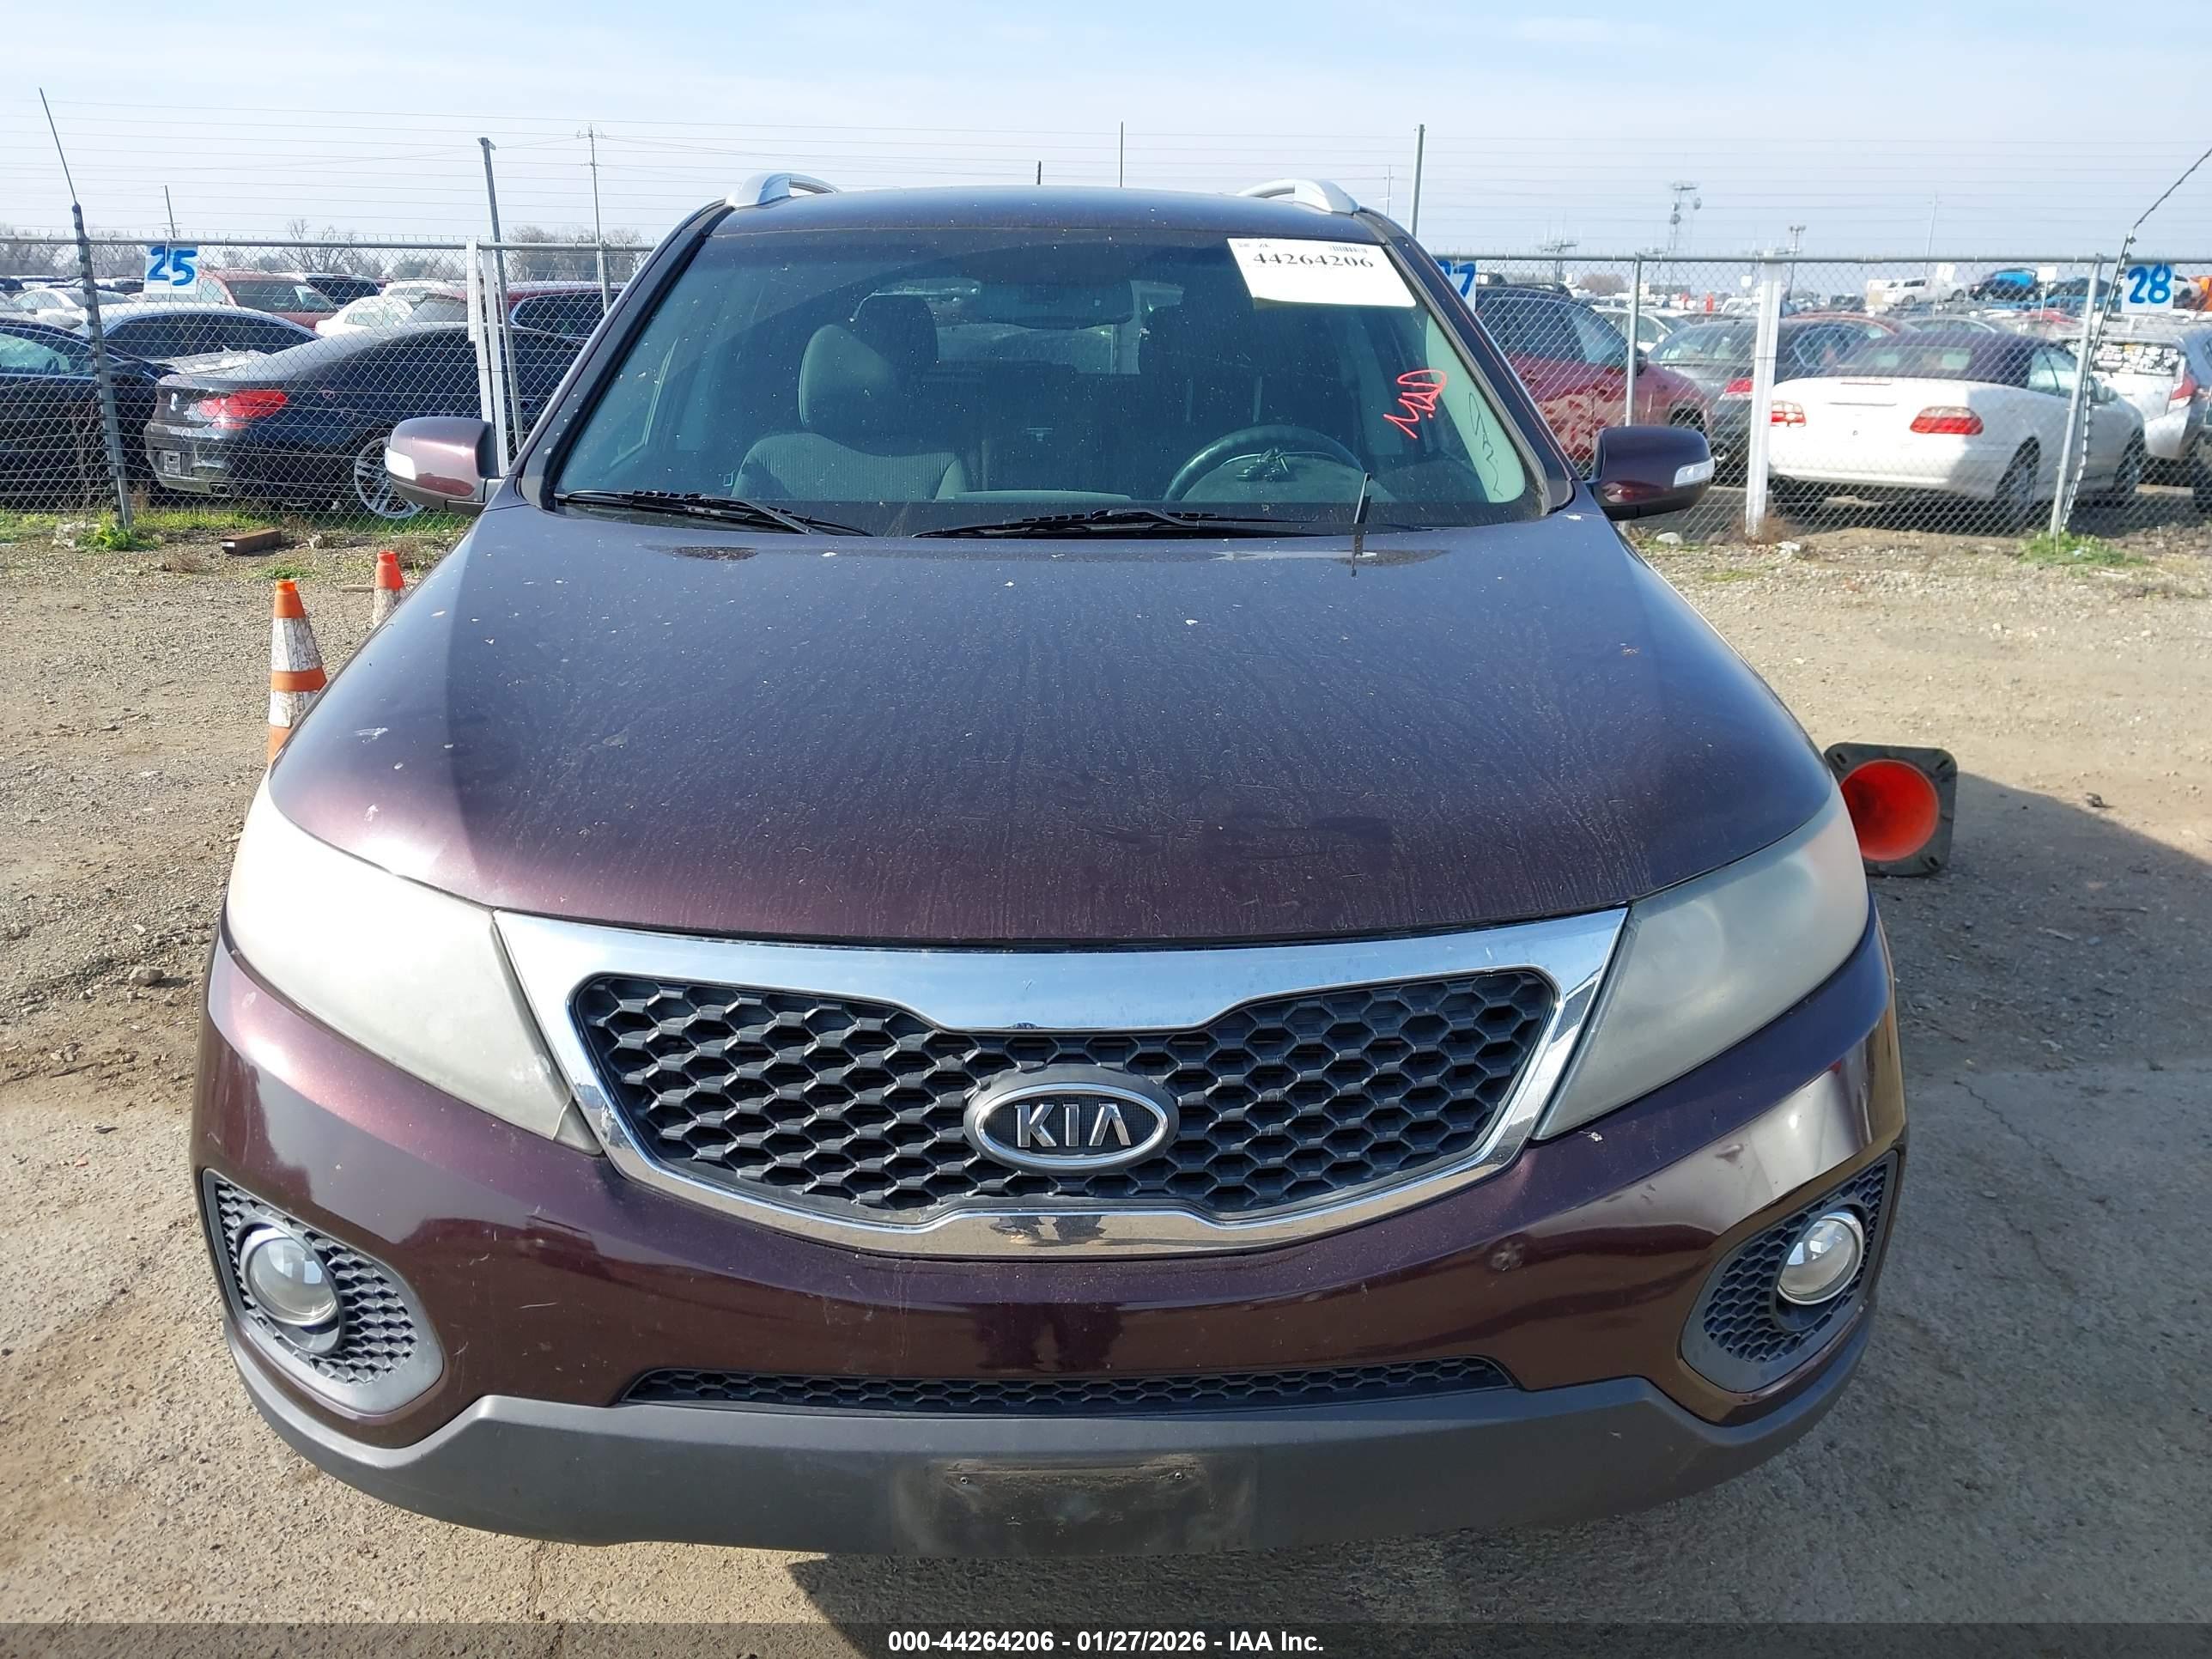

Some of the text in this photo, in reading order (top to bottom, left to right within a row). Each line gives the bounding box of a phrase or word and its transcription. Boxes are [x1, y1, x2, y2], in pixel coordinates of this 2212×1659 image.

[147, 246, 198, 287] 25
[1253, 252, 1374, 268] 44264206
[2128, 260, 2172, 304] 28
[1014, 1103, 1133, 1148] KIA
